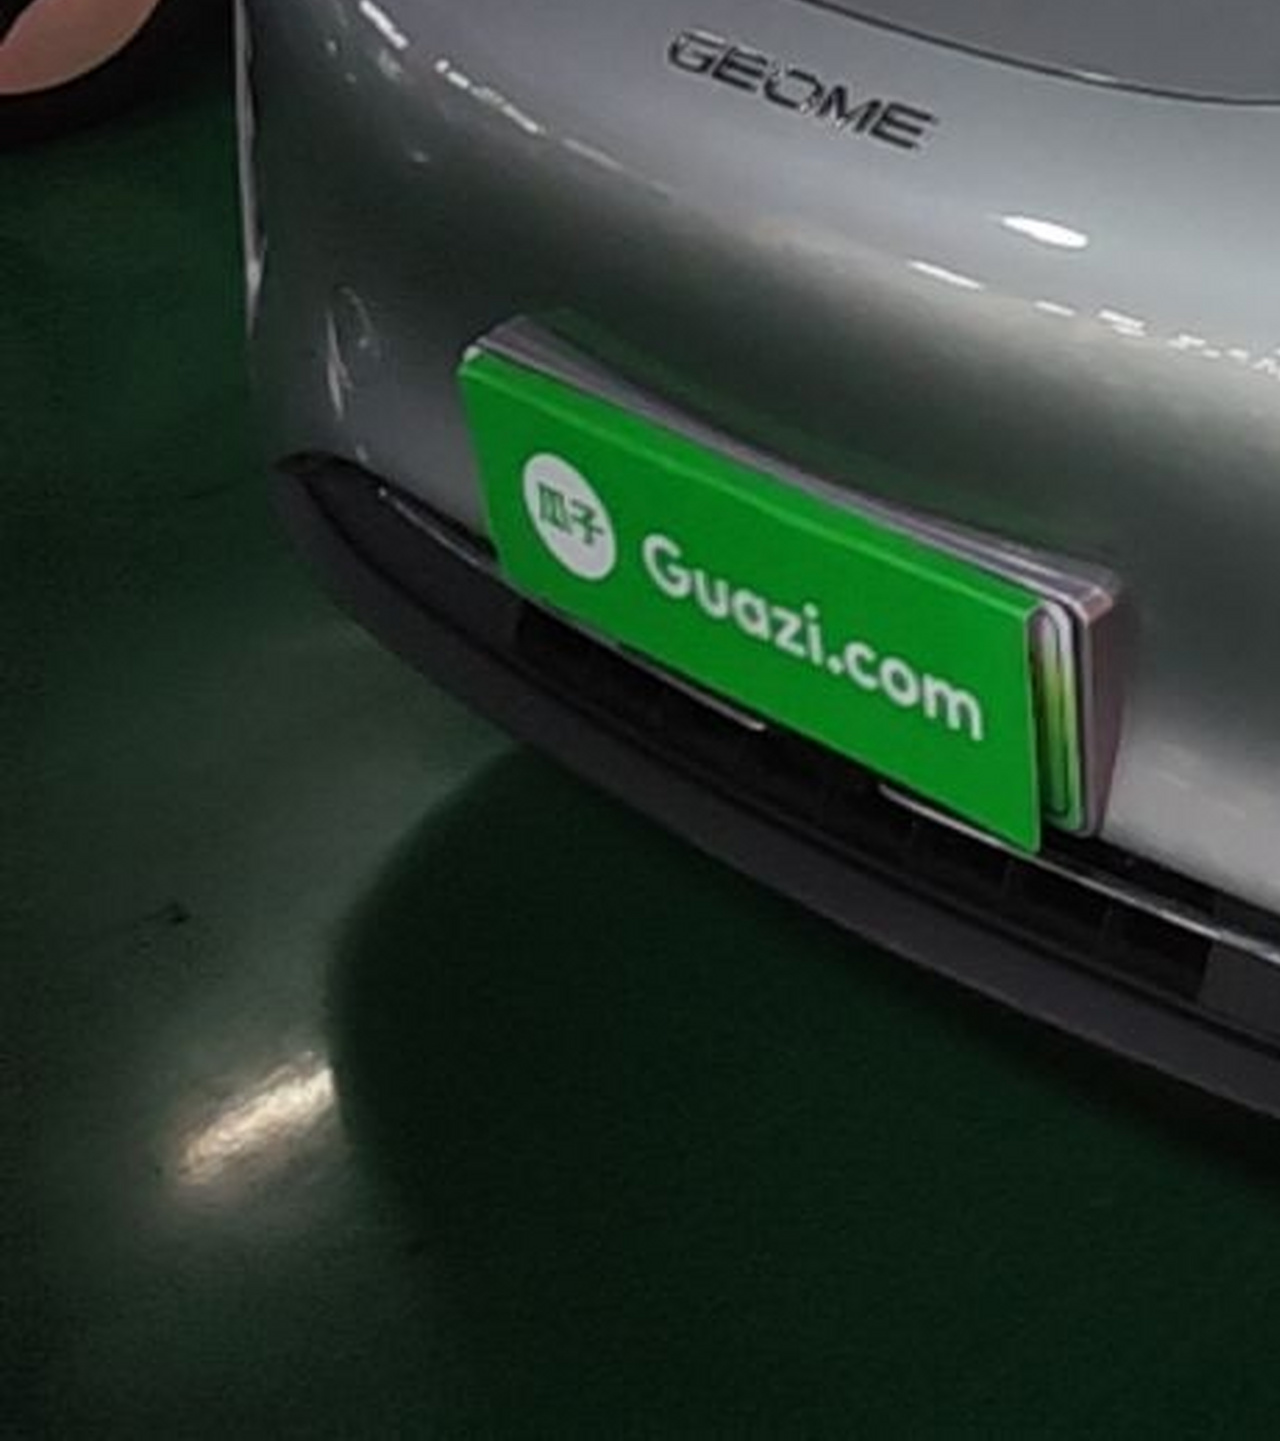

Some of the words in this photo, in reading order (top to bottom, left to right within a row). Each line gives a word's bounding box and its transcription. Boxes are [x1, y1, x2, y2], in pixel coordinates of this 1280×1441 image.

[668, 30, 937, 150] GEOME
[538, 480, 604, 546] 瓜子
[642, 533, 984, 741] Guazi.com
